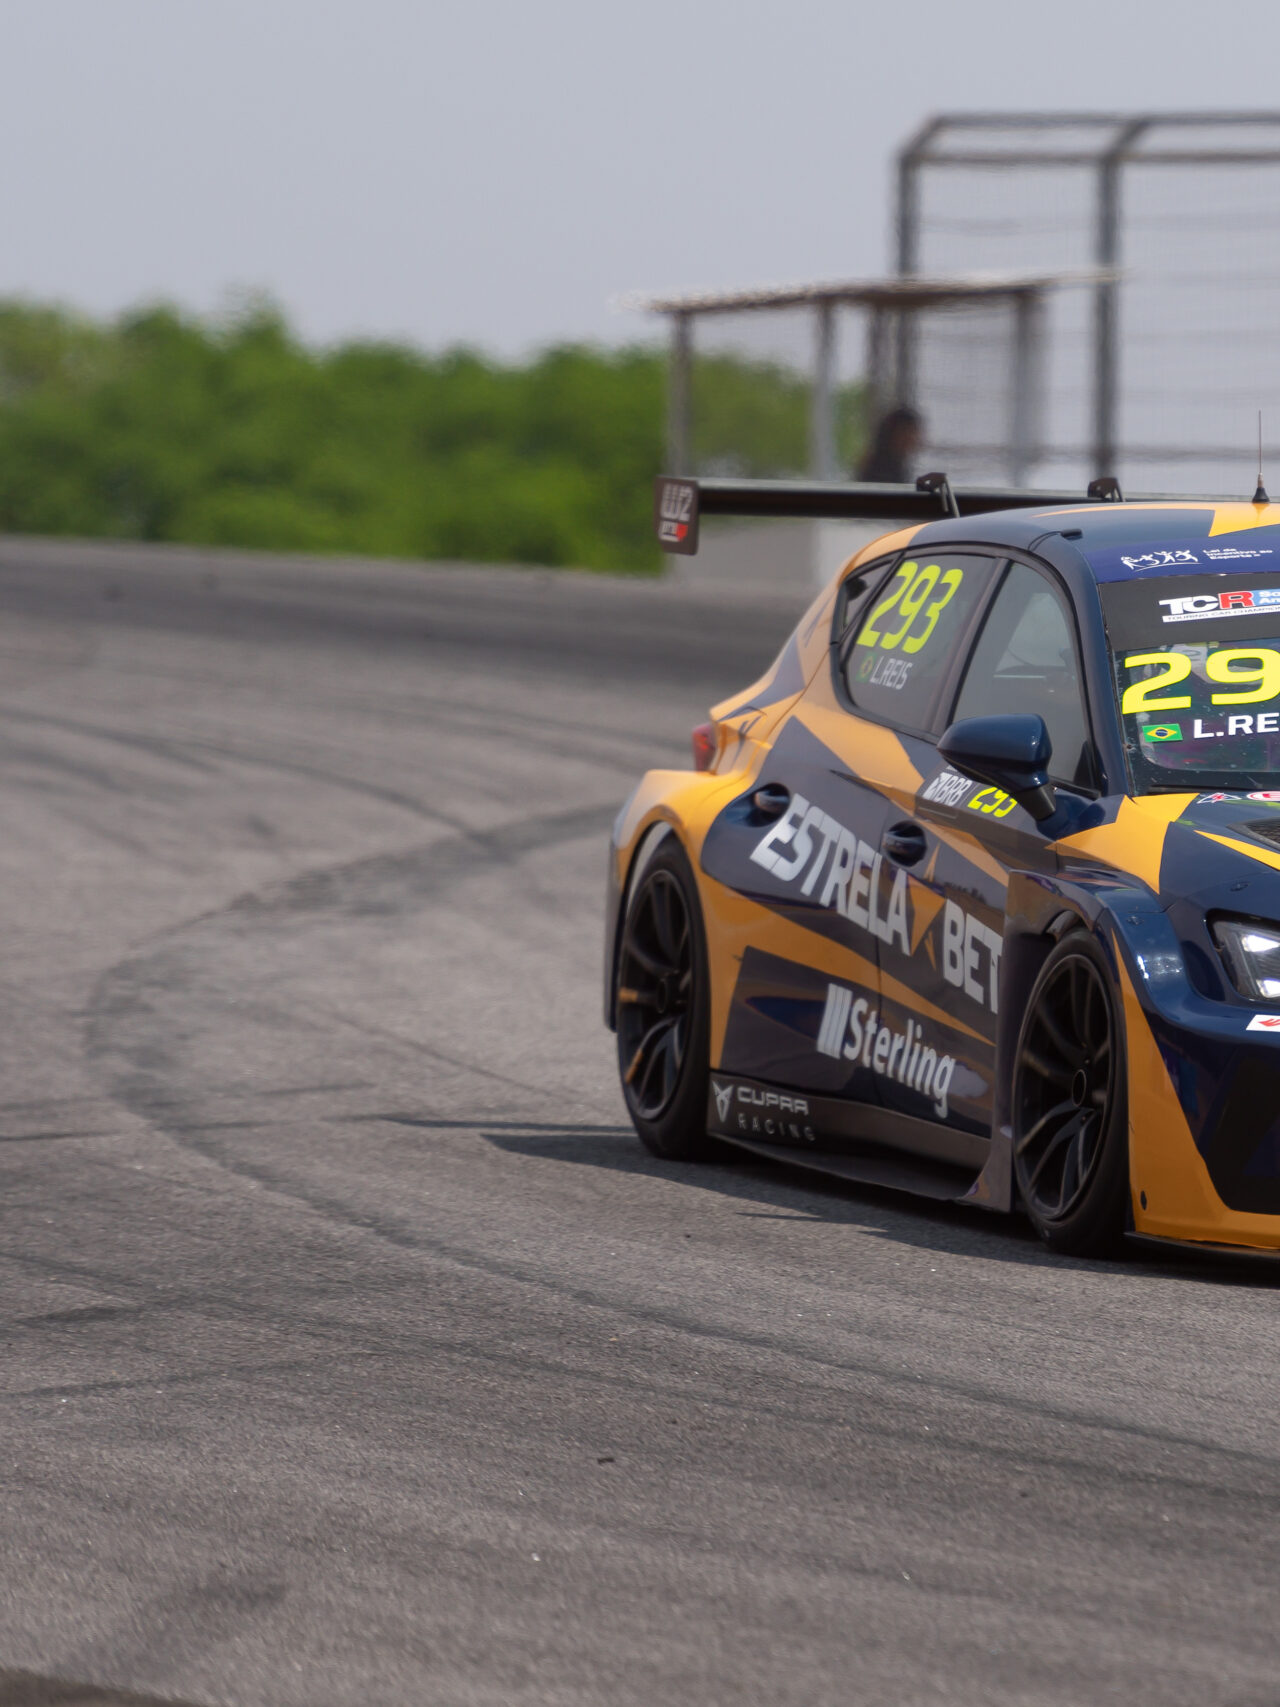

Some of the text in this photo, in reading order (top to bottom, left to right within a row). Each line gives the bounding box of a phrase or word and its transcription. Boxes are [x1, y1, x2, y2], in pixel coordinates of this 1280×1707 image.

[856, 560, 964, 654] 293
[1159, 590, 1256, 615] TCR
[869, 655, 914, 690] L.REIS
[933, 775, 973, 807] BRB
[749, 793, 912, 956] ESTRELA
[943, 898, 1004, 1015] BET
[844, 997, 955, 1118] Sterling
[737, 1086, 809, 1116] CUPRA
[738, 1112, 816, 1142] RACING
